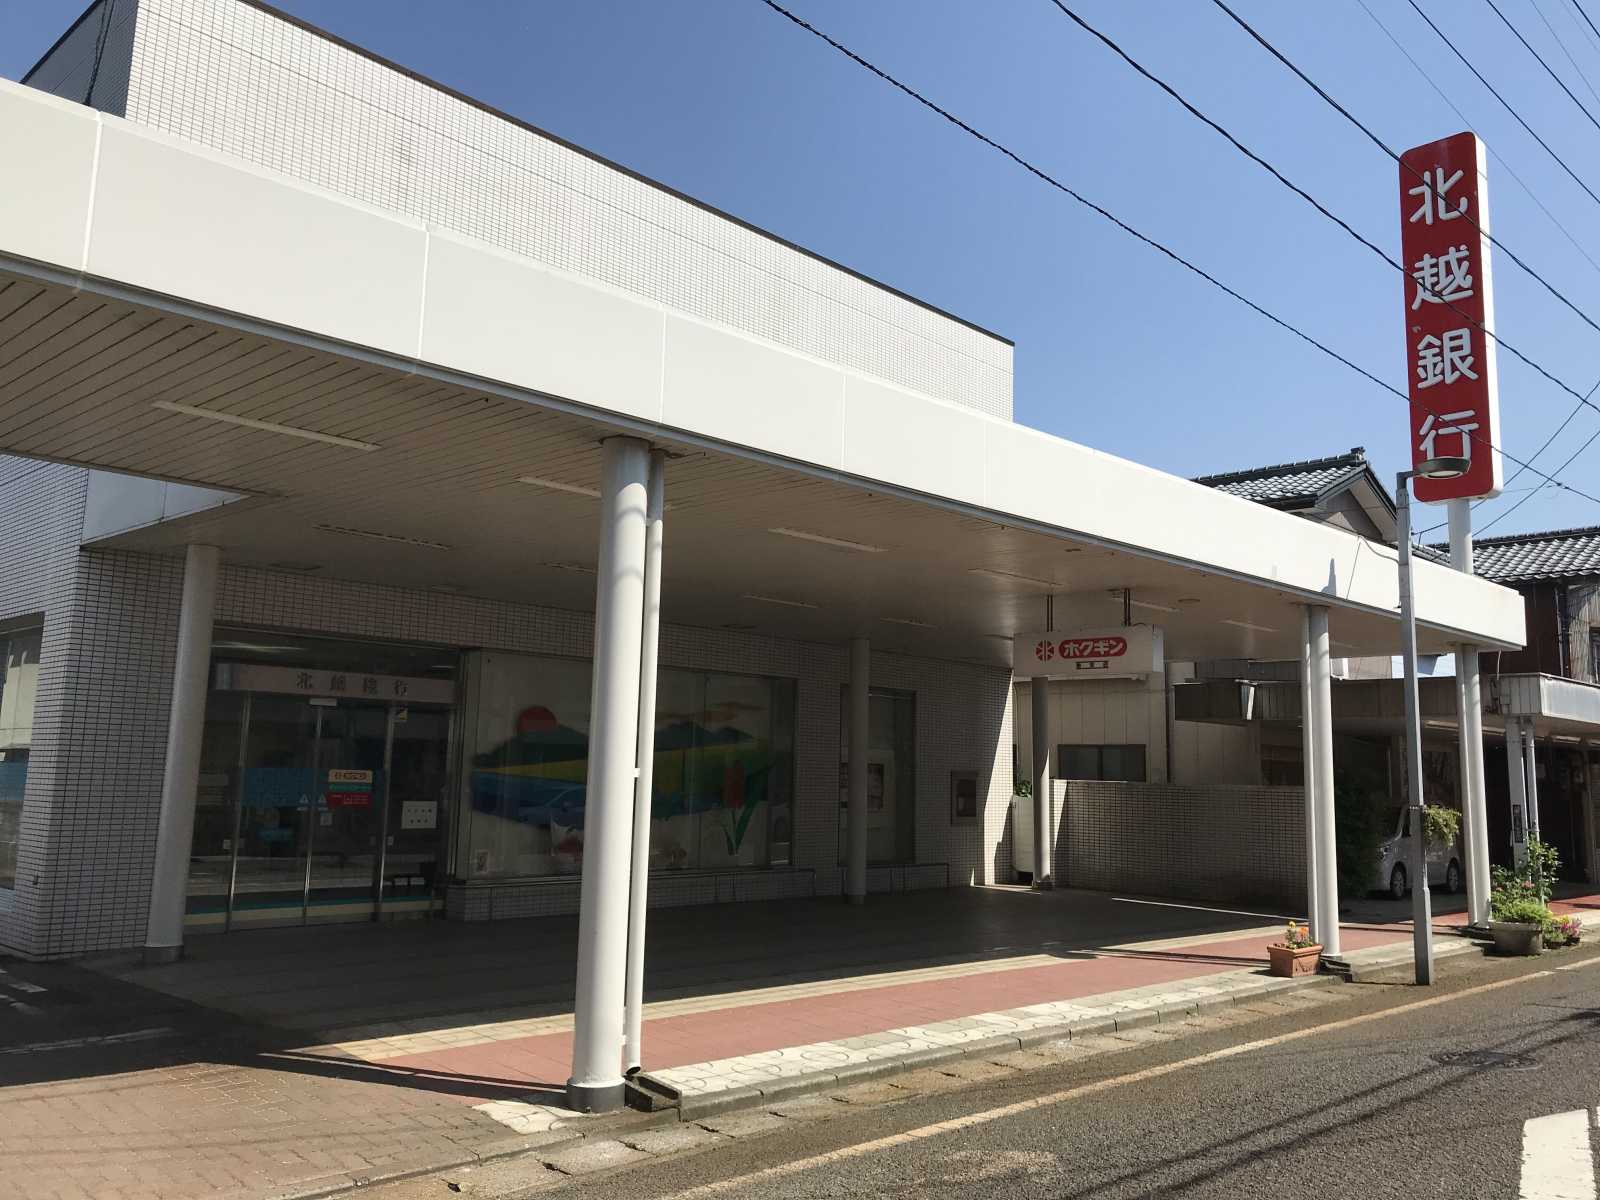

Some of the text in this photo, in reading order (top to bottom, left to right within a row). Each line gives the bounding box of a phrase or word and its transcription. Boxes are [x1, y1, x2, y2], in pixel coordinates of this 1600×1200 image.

[1408, 167, 1479, 467] 北越銀行
[1064, 640, 1123, 657] ホクギン
